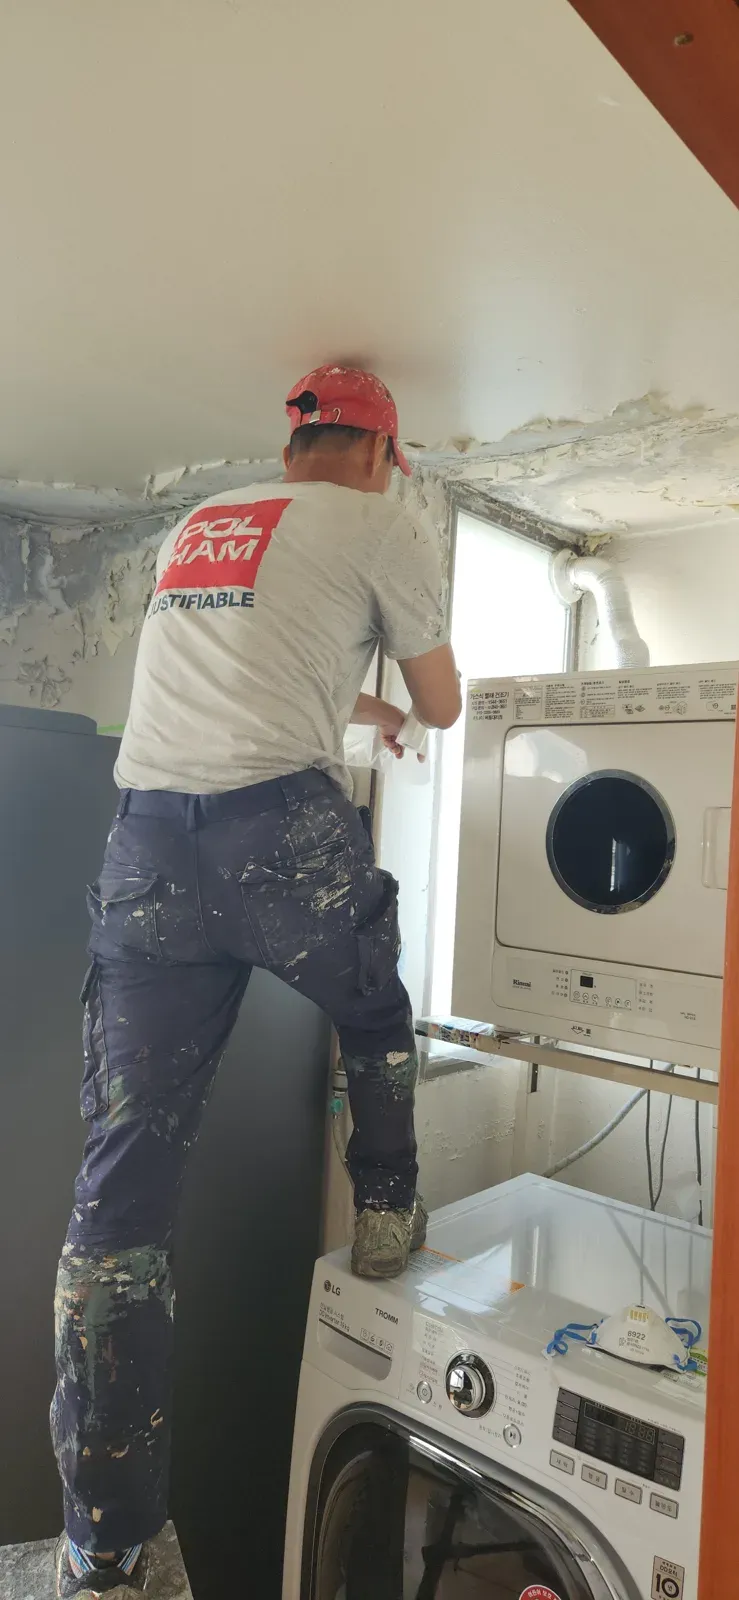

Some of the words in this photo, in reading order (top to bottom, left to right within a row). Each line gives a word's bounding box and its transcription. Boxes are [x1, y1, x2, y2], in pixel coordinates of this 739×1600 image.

[178, 514, 263, 548] POL
[167, 539, 260, 567] HAM
[495, 691, 509, 699] 건조기
[331, 1284, 341, 1297] LG
[375, 1307, 399, 1325] TROMM
